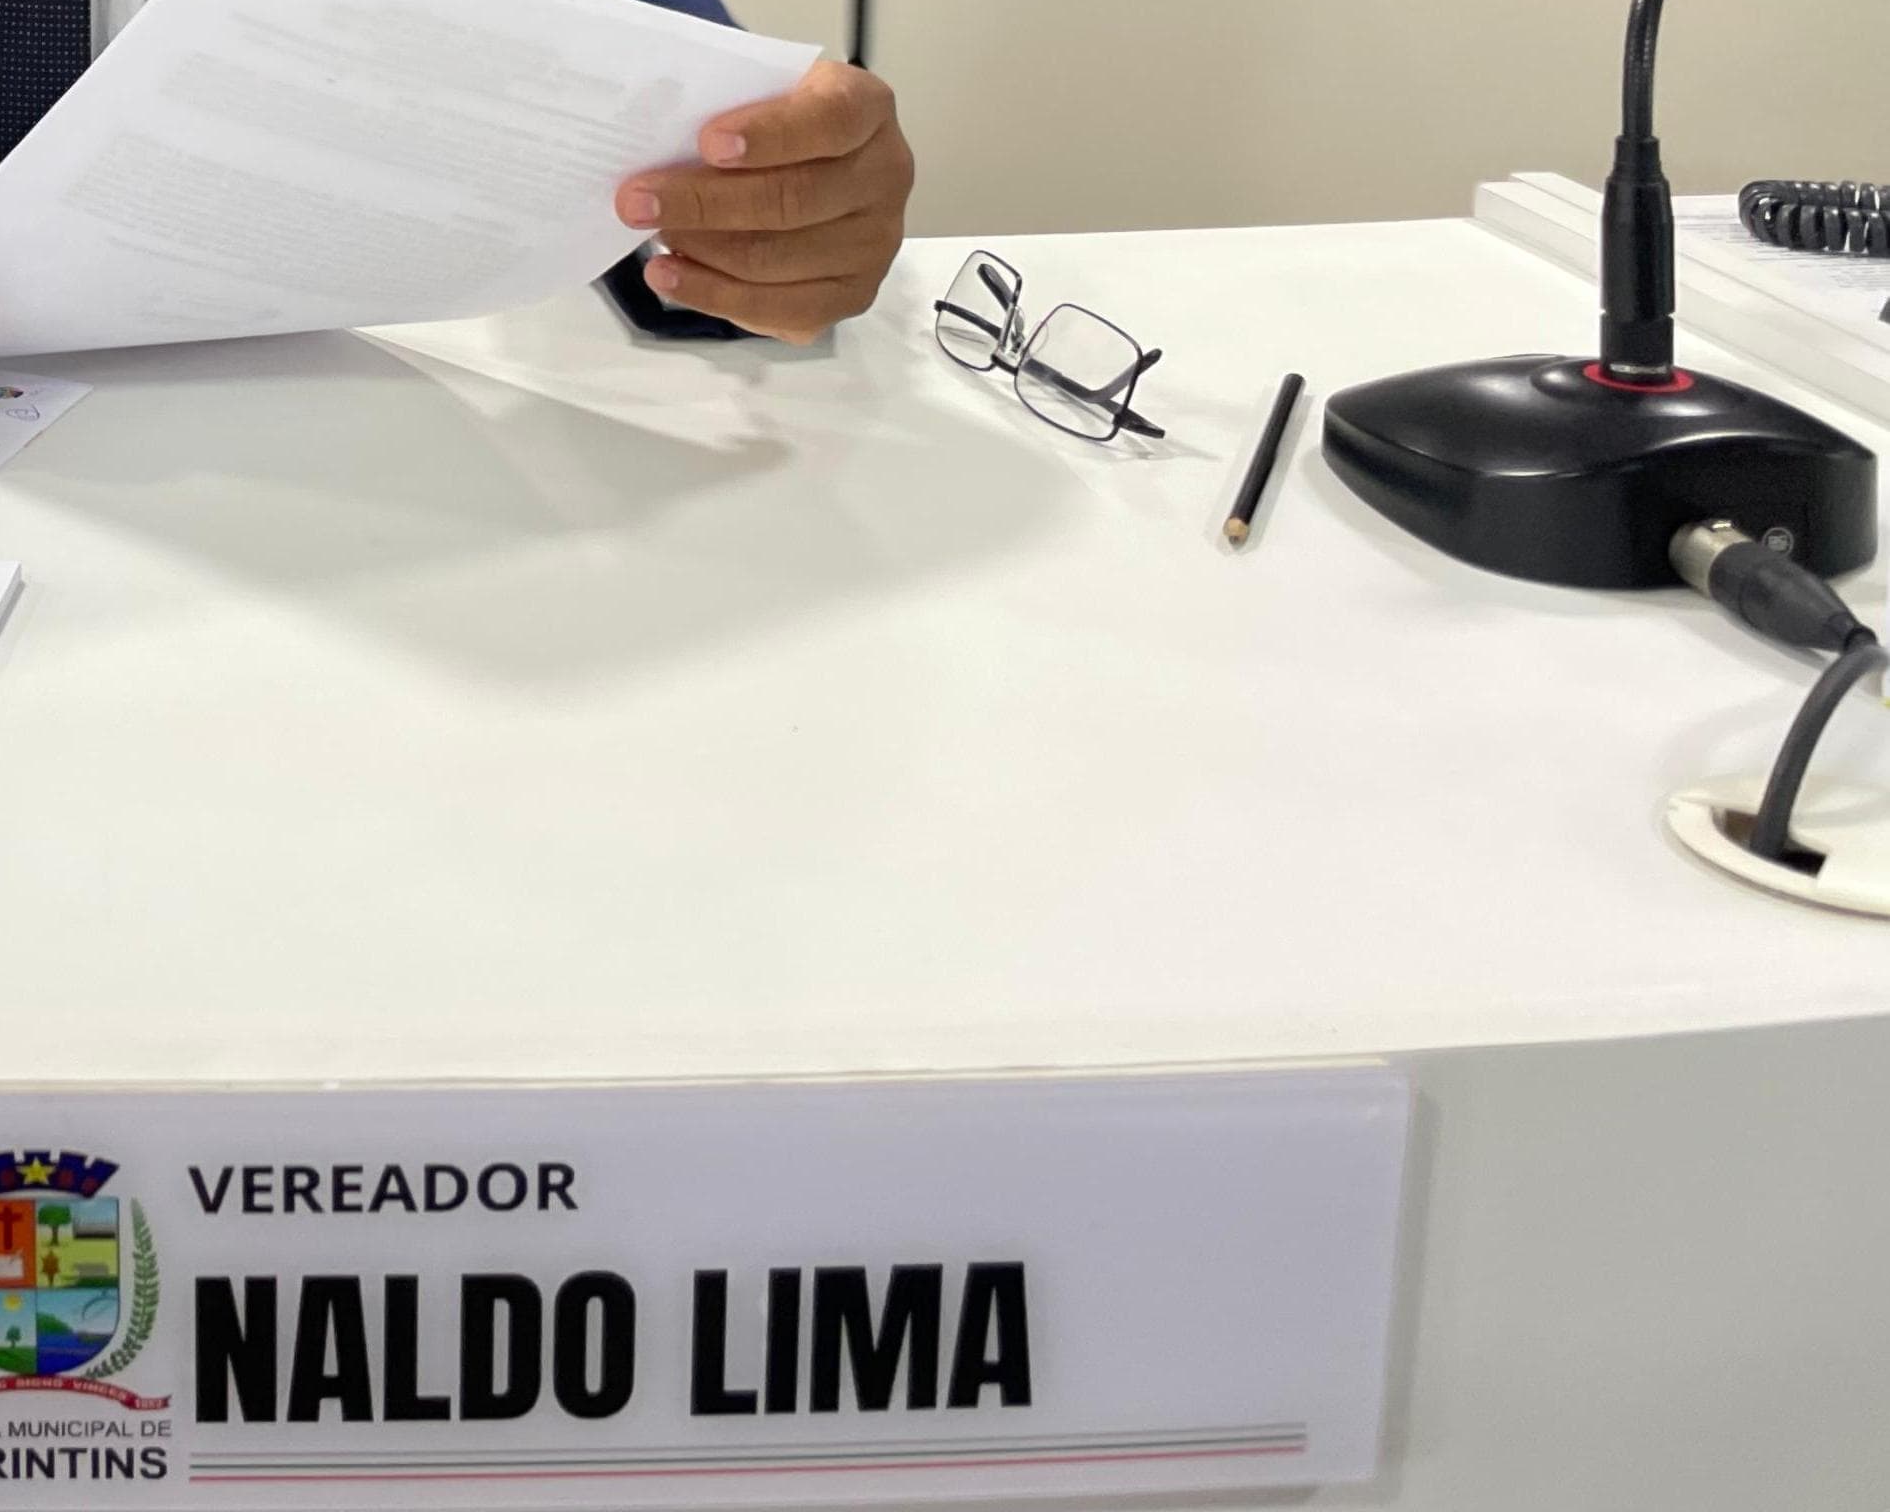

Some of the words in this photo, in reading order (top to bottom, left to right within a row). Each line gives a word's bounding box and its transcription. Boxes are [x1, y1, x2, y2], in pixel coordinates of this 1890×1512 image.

[188, 1162, 579, 1214] VEREADOR
[195, 1270, 636, 1424] NALDO
[690, 1261, 1032, 1416] LIMA
[14, 1377, 63, 1389] SIGNO
[7, 1419, 134, 1438] MUNICIPAL
[140, 1419, 173, 1438] DE
